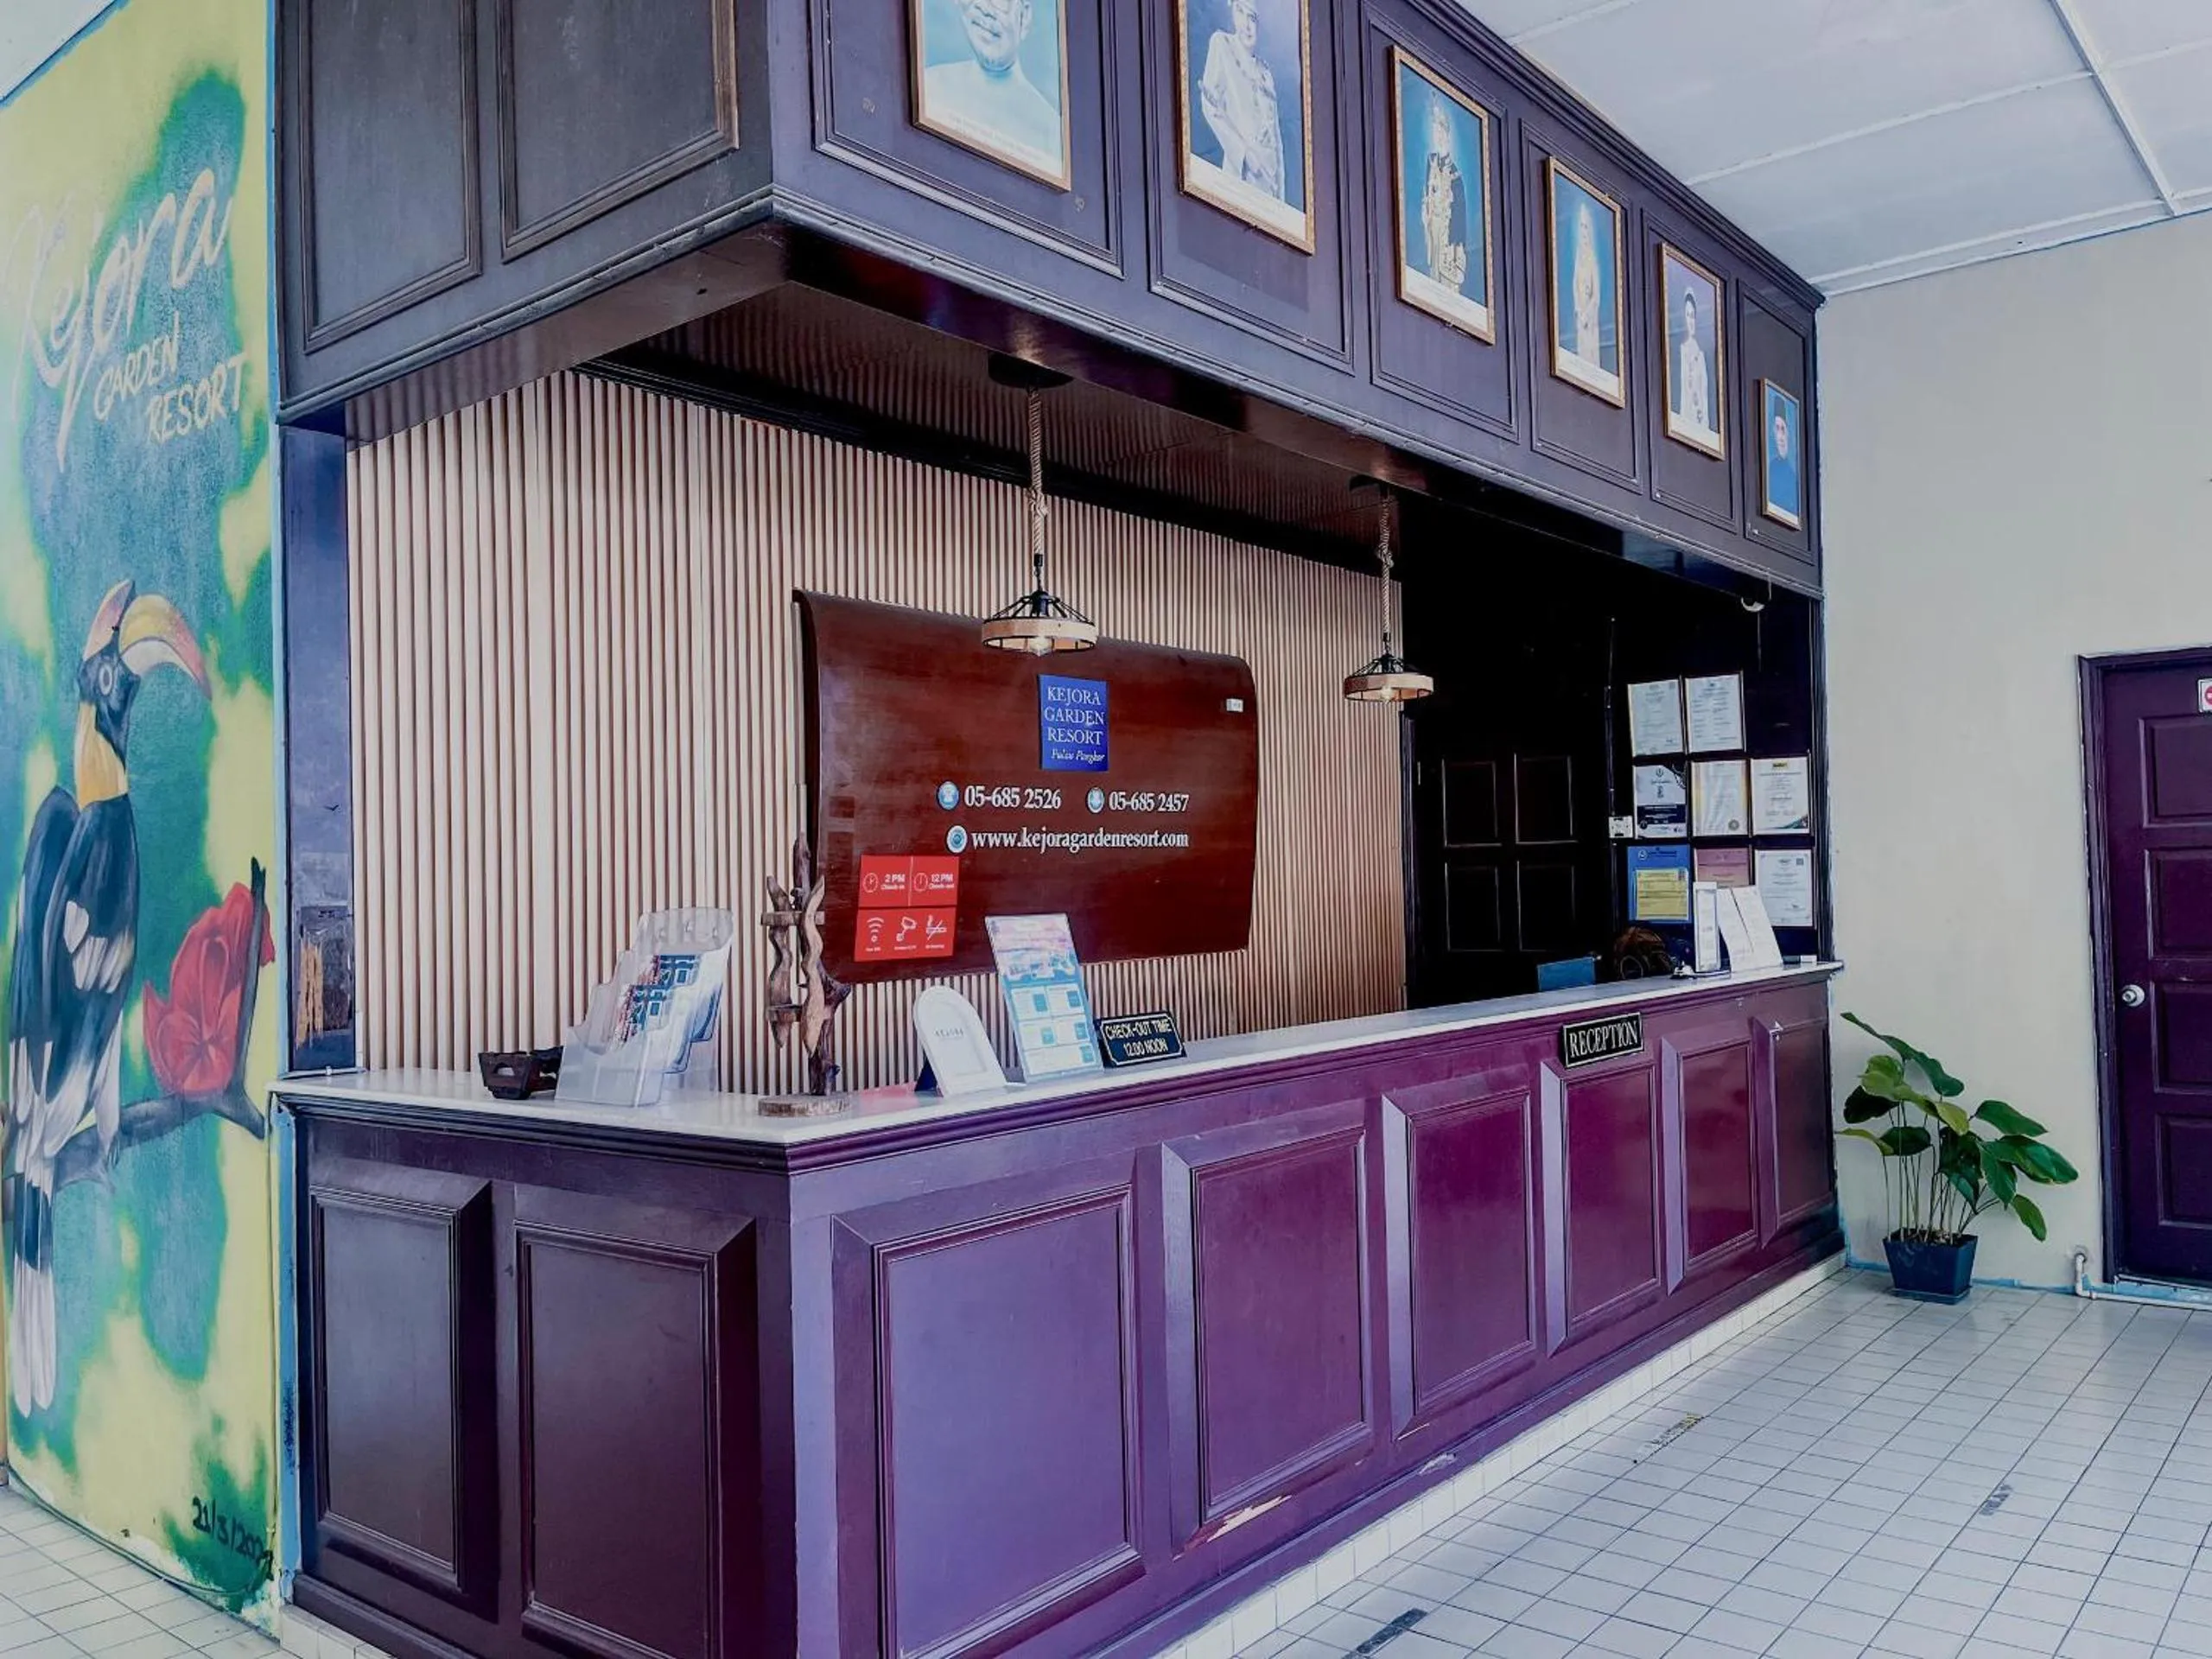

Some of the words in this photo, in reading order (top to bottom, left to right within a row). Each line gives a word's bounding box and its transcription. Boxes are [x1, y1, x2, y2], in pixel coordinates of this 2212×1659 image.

[93, 310, 180, 421] GARDEN
[146, 352, 248, 443] RESORT
[1047, 686, 1102, 707] KEJORA
[1044, 705, 1105, 726] GARDEN
[1047, 726, 1103, 746] RESORT
[963, 785, 1021, 809] 05-685
[1024, 788, 1062, 810] 2526
[1109, 791, 1155, 811] 05-685
[1158, 793, 1190, 813] 2457
[971, 826, 1189, 854] www.kejoragardenresort.com
[1105, 1021, 1152, 1040] CHECK-OUT
[1152, 1019, 1172, 1033] TIME
[1569, 1020, 1638, 1058] RECEPTION
[1144, 1038, 1168, 1054] NOON
